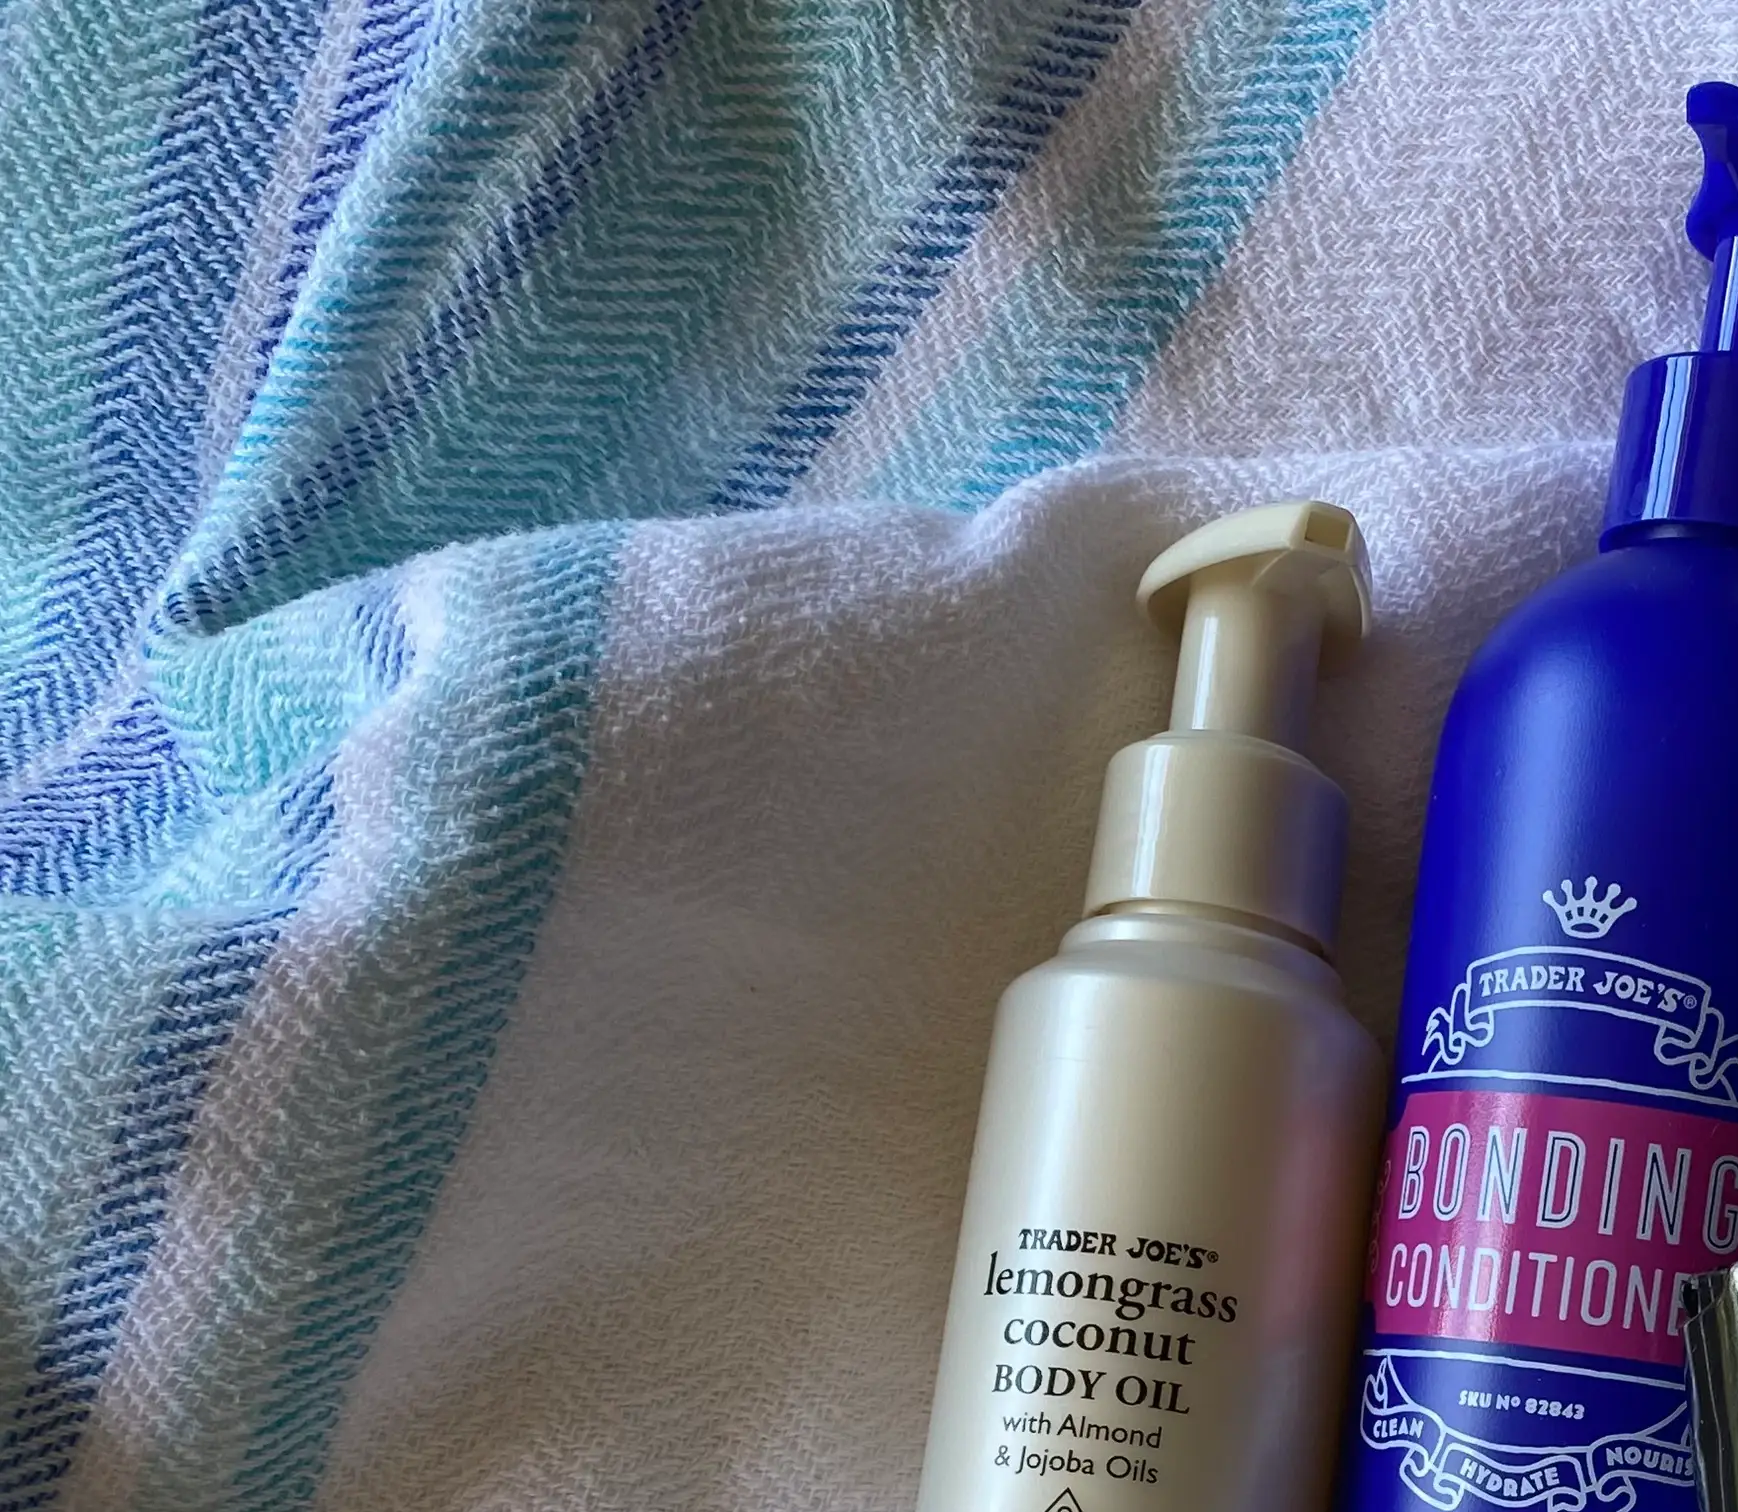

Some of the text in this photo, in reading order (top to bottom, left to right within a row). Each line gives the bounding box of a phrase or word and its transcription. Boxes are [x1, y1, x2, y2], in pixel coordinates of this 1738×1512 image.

[1478, 966, 1585, 998] TRADER
[1018, 1229, 1116, 1256] TRADER
[984, 1252, 1238, 1323] lemongrass
[1386, 1244, 1692, 1336] CONDITIONE
[1003, 1318, 1195, 1365] coconut
[992, 1365, 1190, 1414] BODY OIL
[1458, 1390, 1493, 1409] SKU
[1525, 1401, 1585, 1420] 82843
[1003, 1412, 1162, 1449] with Almond
[1373, 1418, 1424, 1439] CLEAN
[994, 1445, 1158, 1484] & Jojoba Oils
[1460, 1459, 1560, 1498] HYDRATE
[1606, 1446, 1694, 1476] NOURIS
